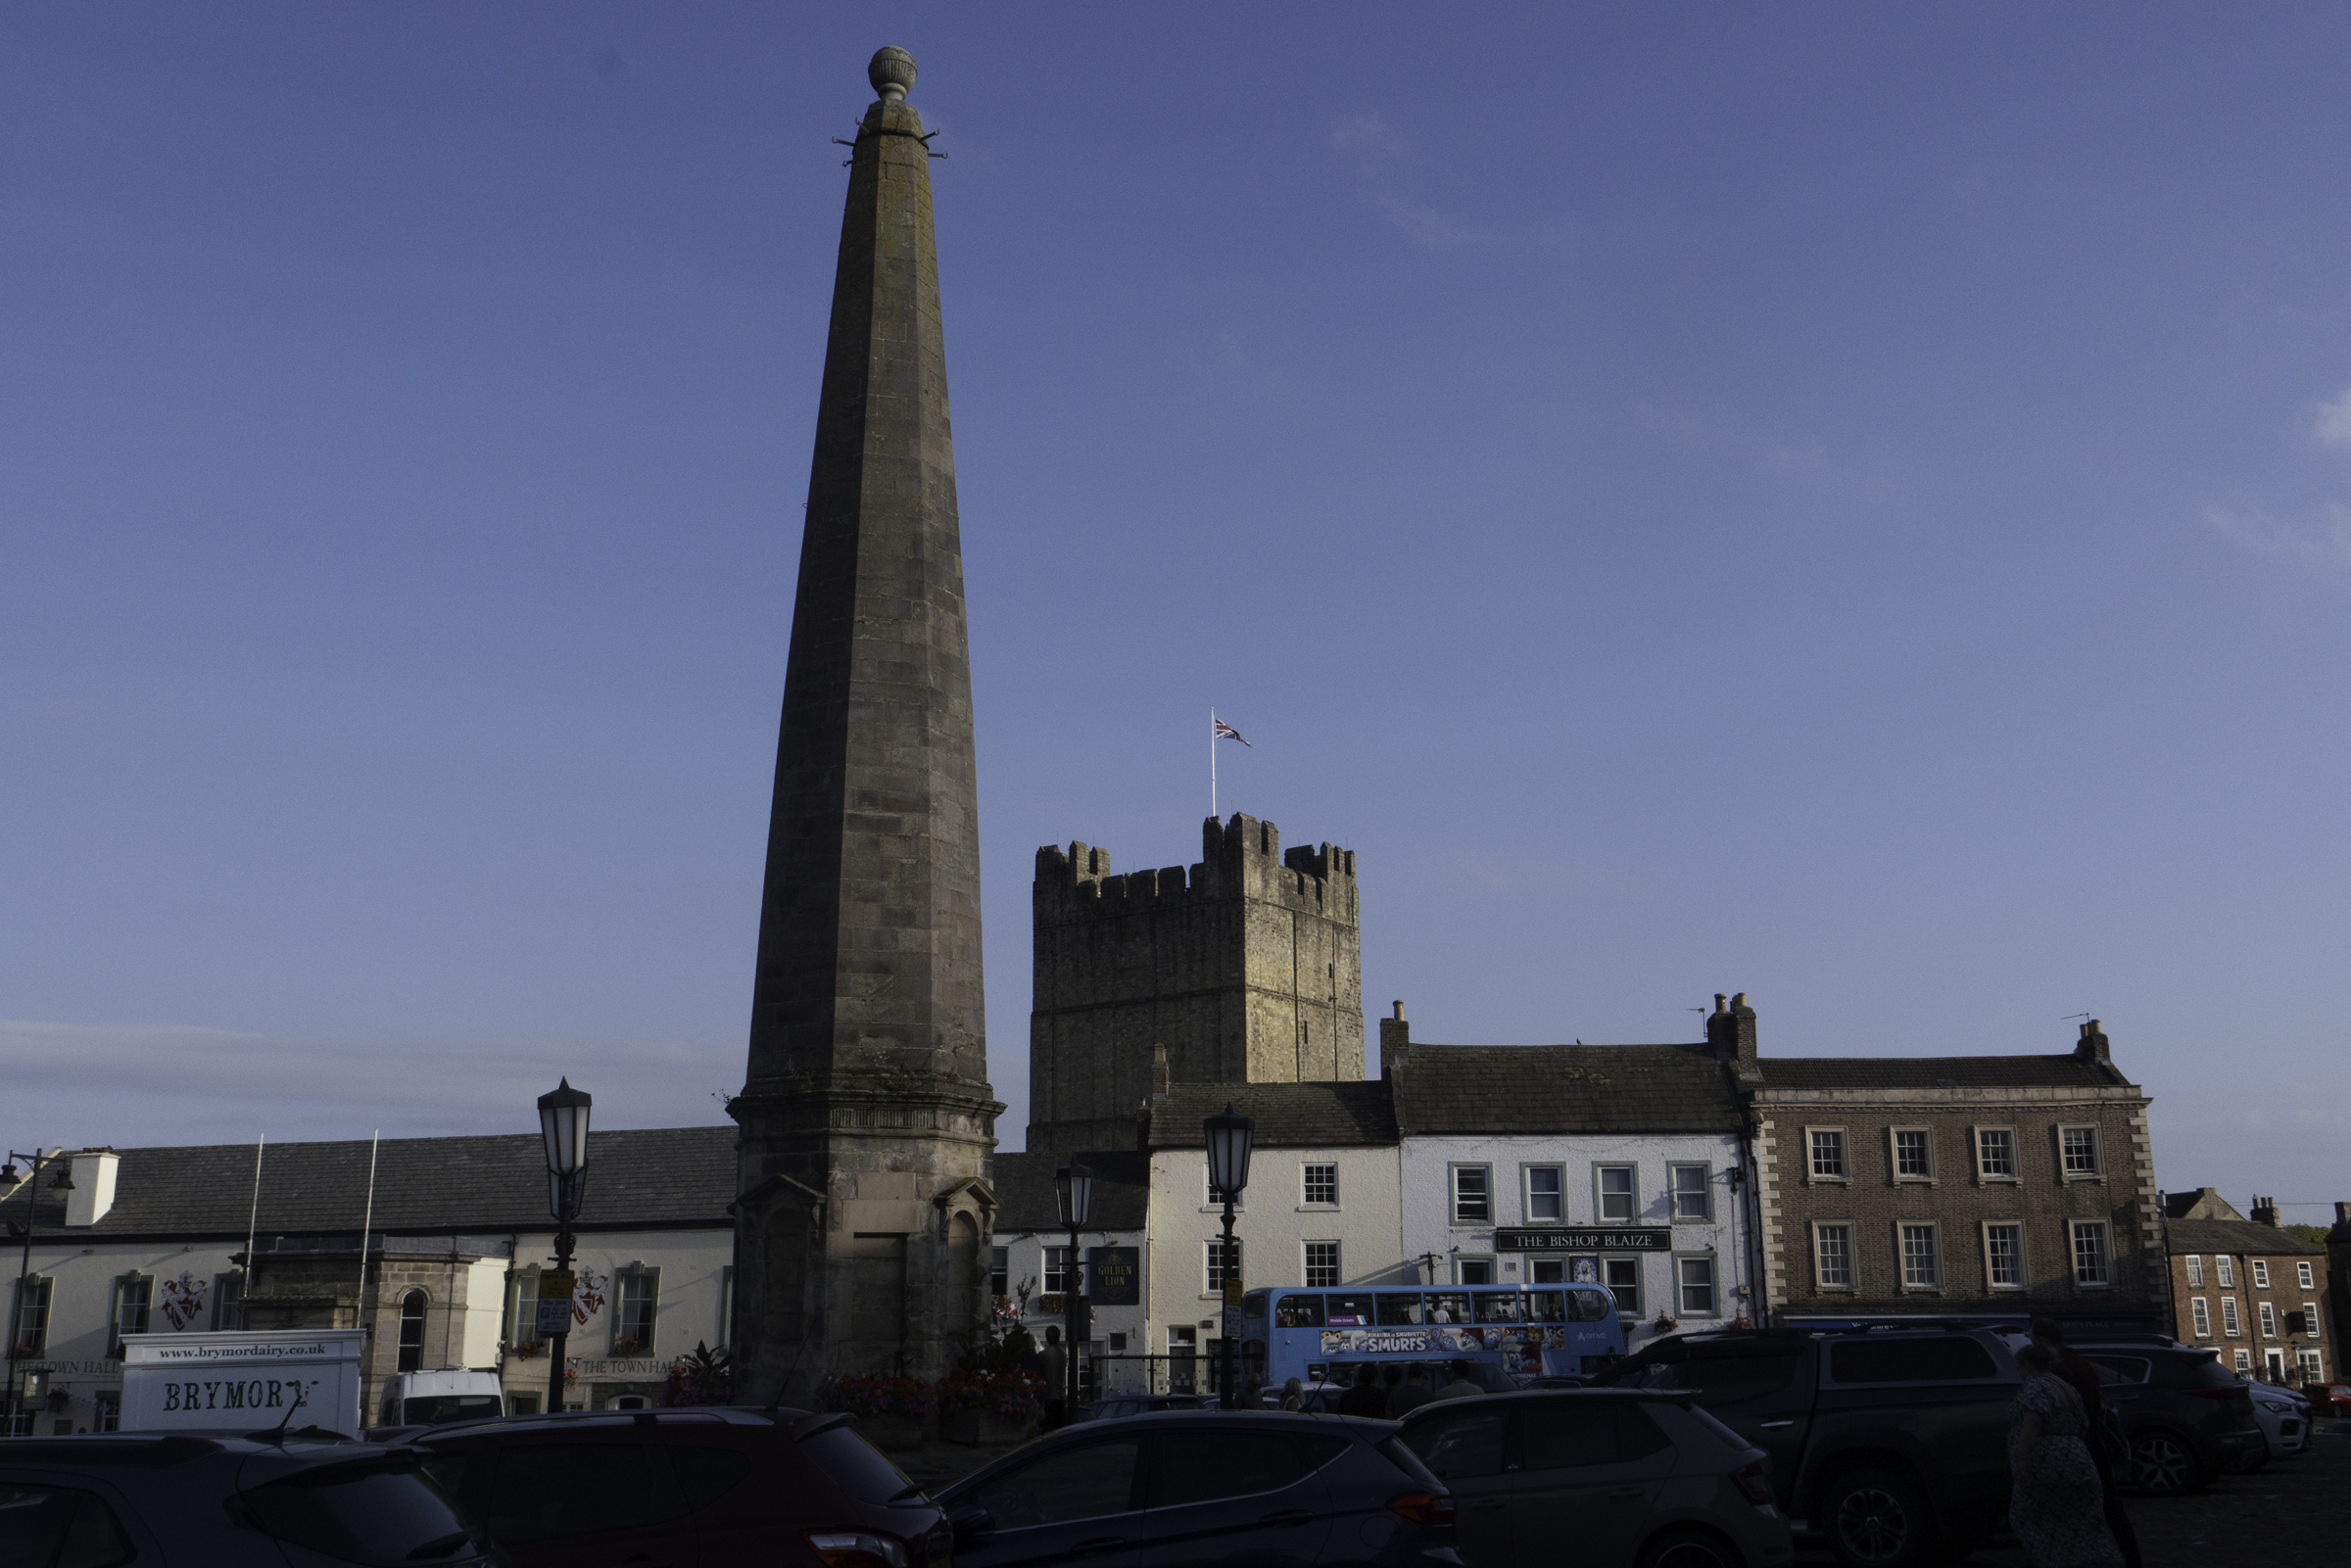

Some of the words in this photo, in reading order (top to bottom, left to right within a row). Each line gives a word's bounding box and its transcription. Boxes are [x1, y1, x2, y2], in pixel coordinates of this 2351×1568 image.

[1513, 1235, 1545, 1248] THE
[1549, 1234, 1599, 1248] BISHOP
[1604, 1234, 1654, 1247] BLAIZE
[1097, 1264, 1132, 1276] GOLDEN
[1105, 1275, 1126, 1286] LION
[160, 1344, 326, 1359] www.brymordairy.co.uk
[1367, 1337, 1427, 1352] SMURFS
[38, 1360, 80, 1374] TOWN
[84, 1360, 120, 1374] HALL
[583, 1360, 607, 1373] THE
[611, 1360, 647, 1373] TOWN
[163, 1379, 284, 1411] BRYMOR
